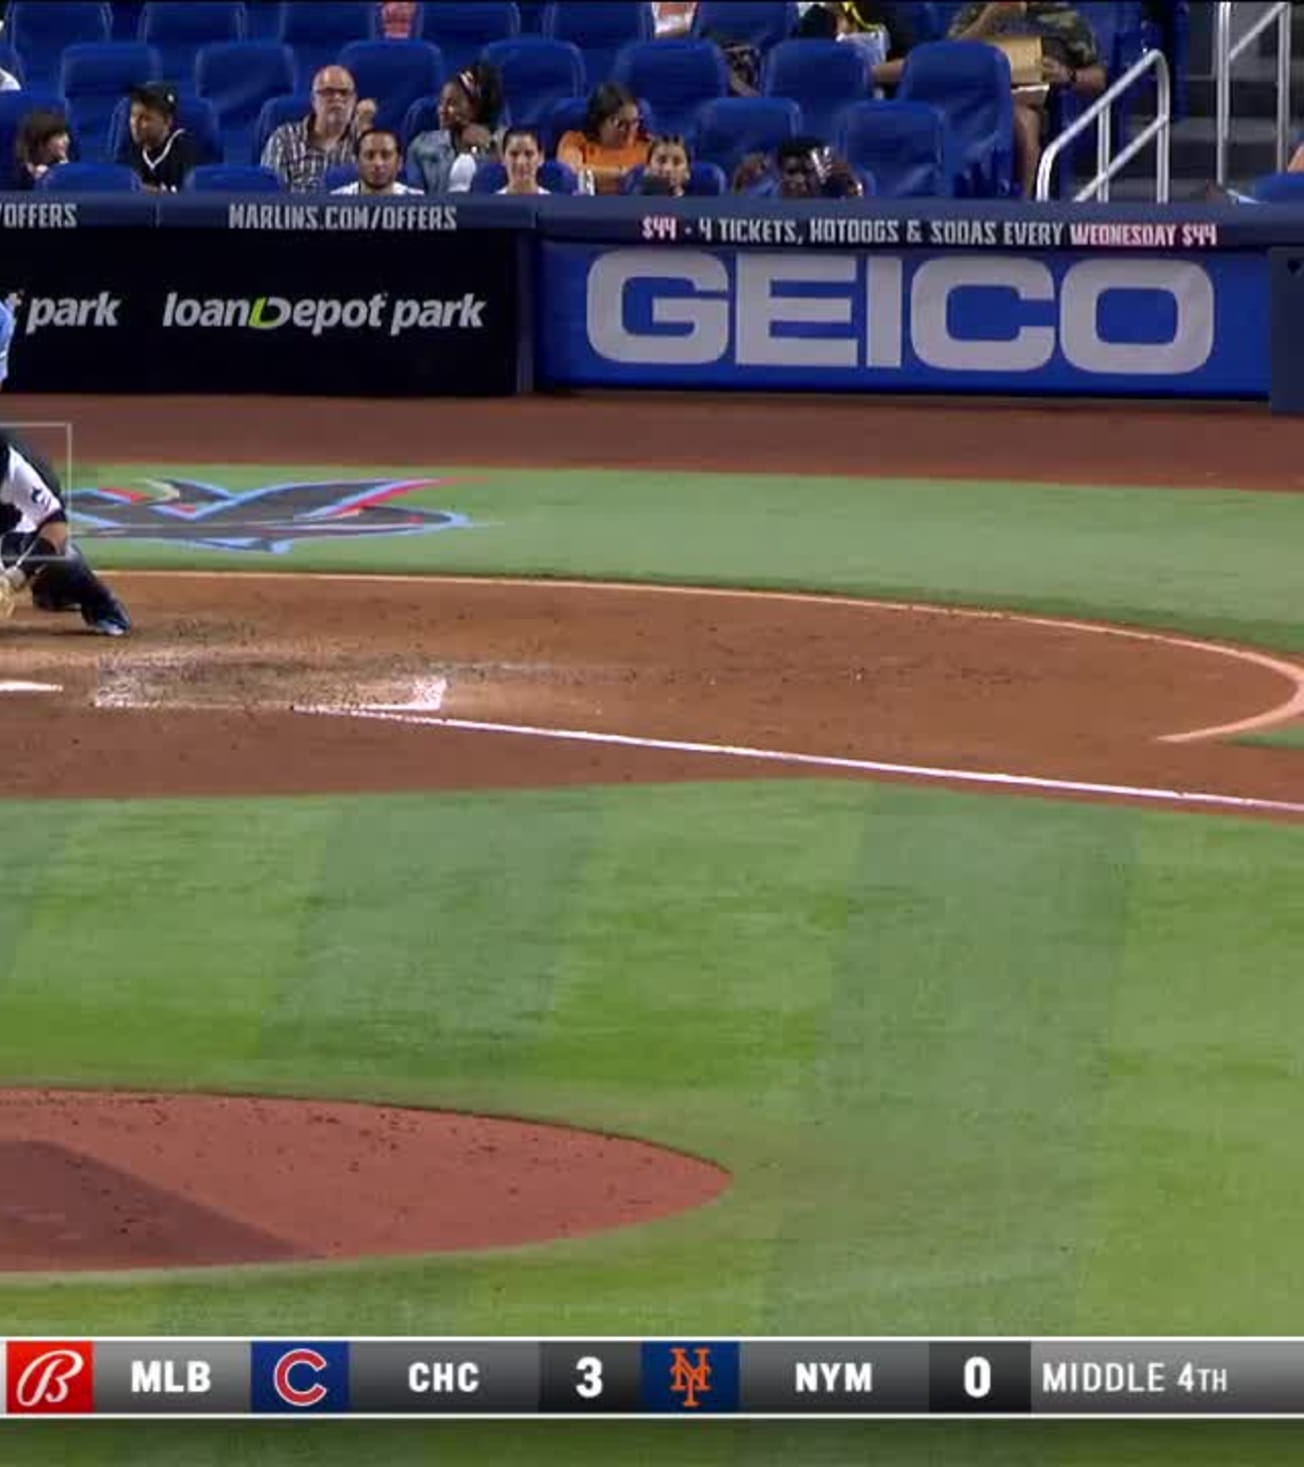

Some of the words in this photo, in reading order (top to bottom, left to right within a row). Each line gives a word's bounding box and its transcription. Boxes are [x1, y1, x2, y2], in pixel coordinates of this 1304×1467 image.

[228, 203, 458, 230] MARLINS.COM/OFFERS
[641, 216, 677, 240] $44
[698, 217, 712, 241] 4
[718, 217, 805, 244] TICKETS,
[809, 217, 900, 243] HOTDOGS
[906, 219, 922, 243] &
[930, 220, 996, 245] SODAS
[1003, 221, 1064, 245] EVERY
[1070, 222, 1178, 246] WEDNESDAY
[1182, 223, 1217, 247] $44
[25, 291, 122, 334] park
[162, 291, 388, 336] loanDepot
[390, 293, 487, 336] park
[586, 251, 1215, 375] GEICO
